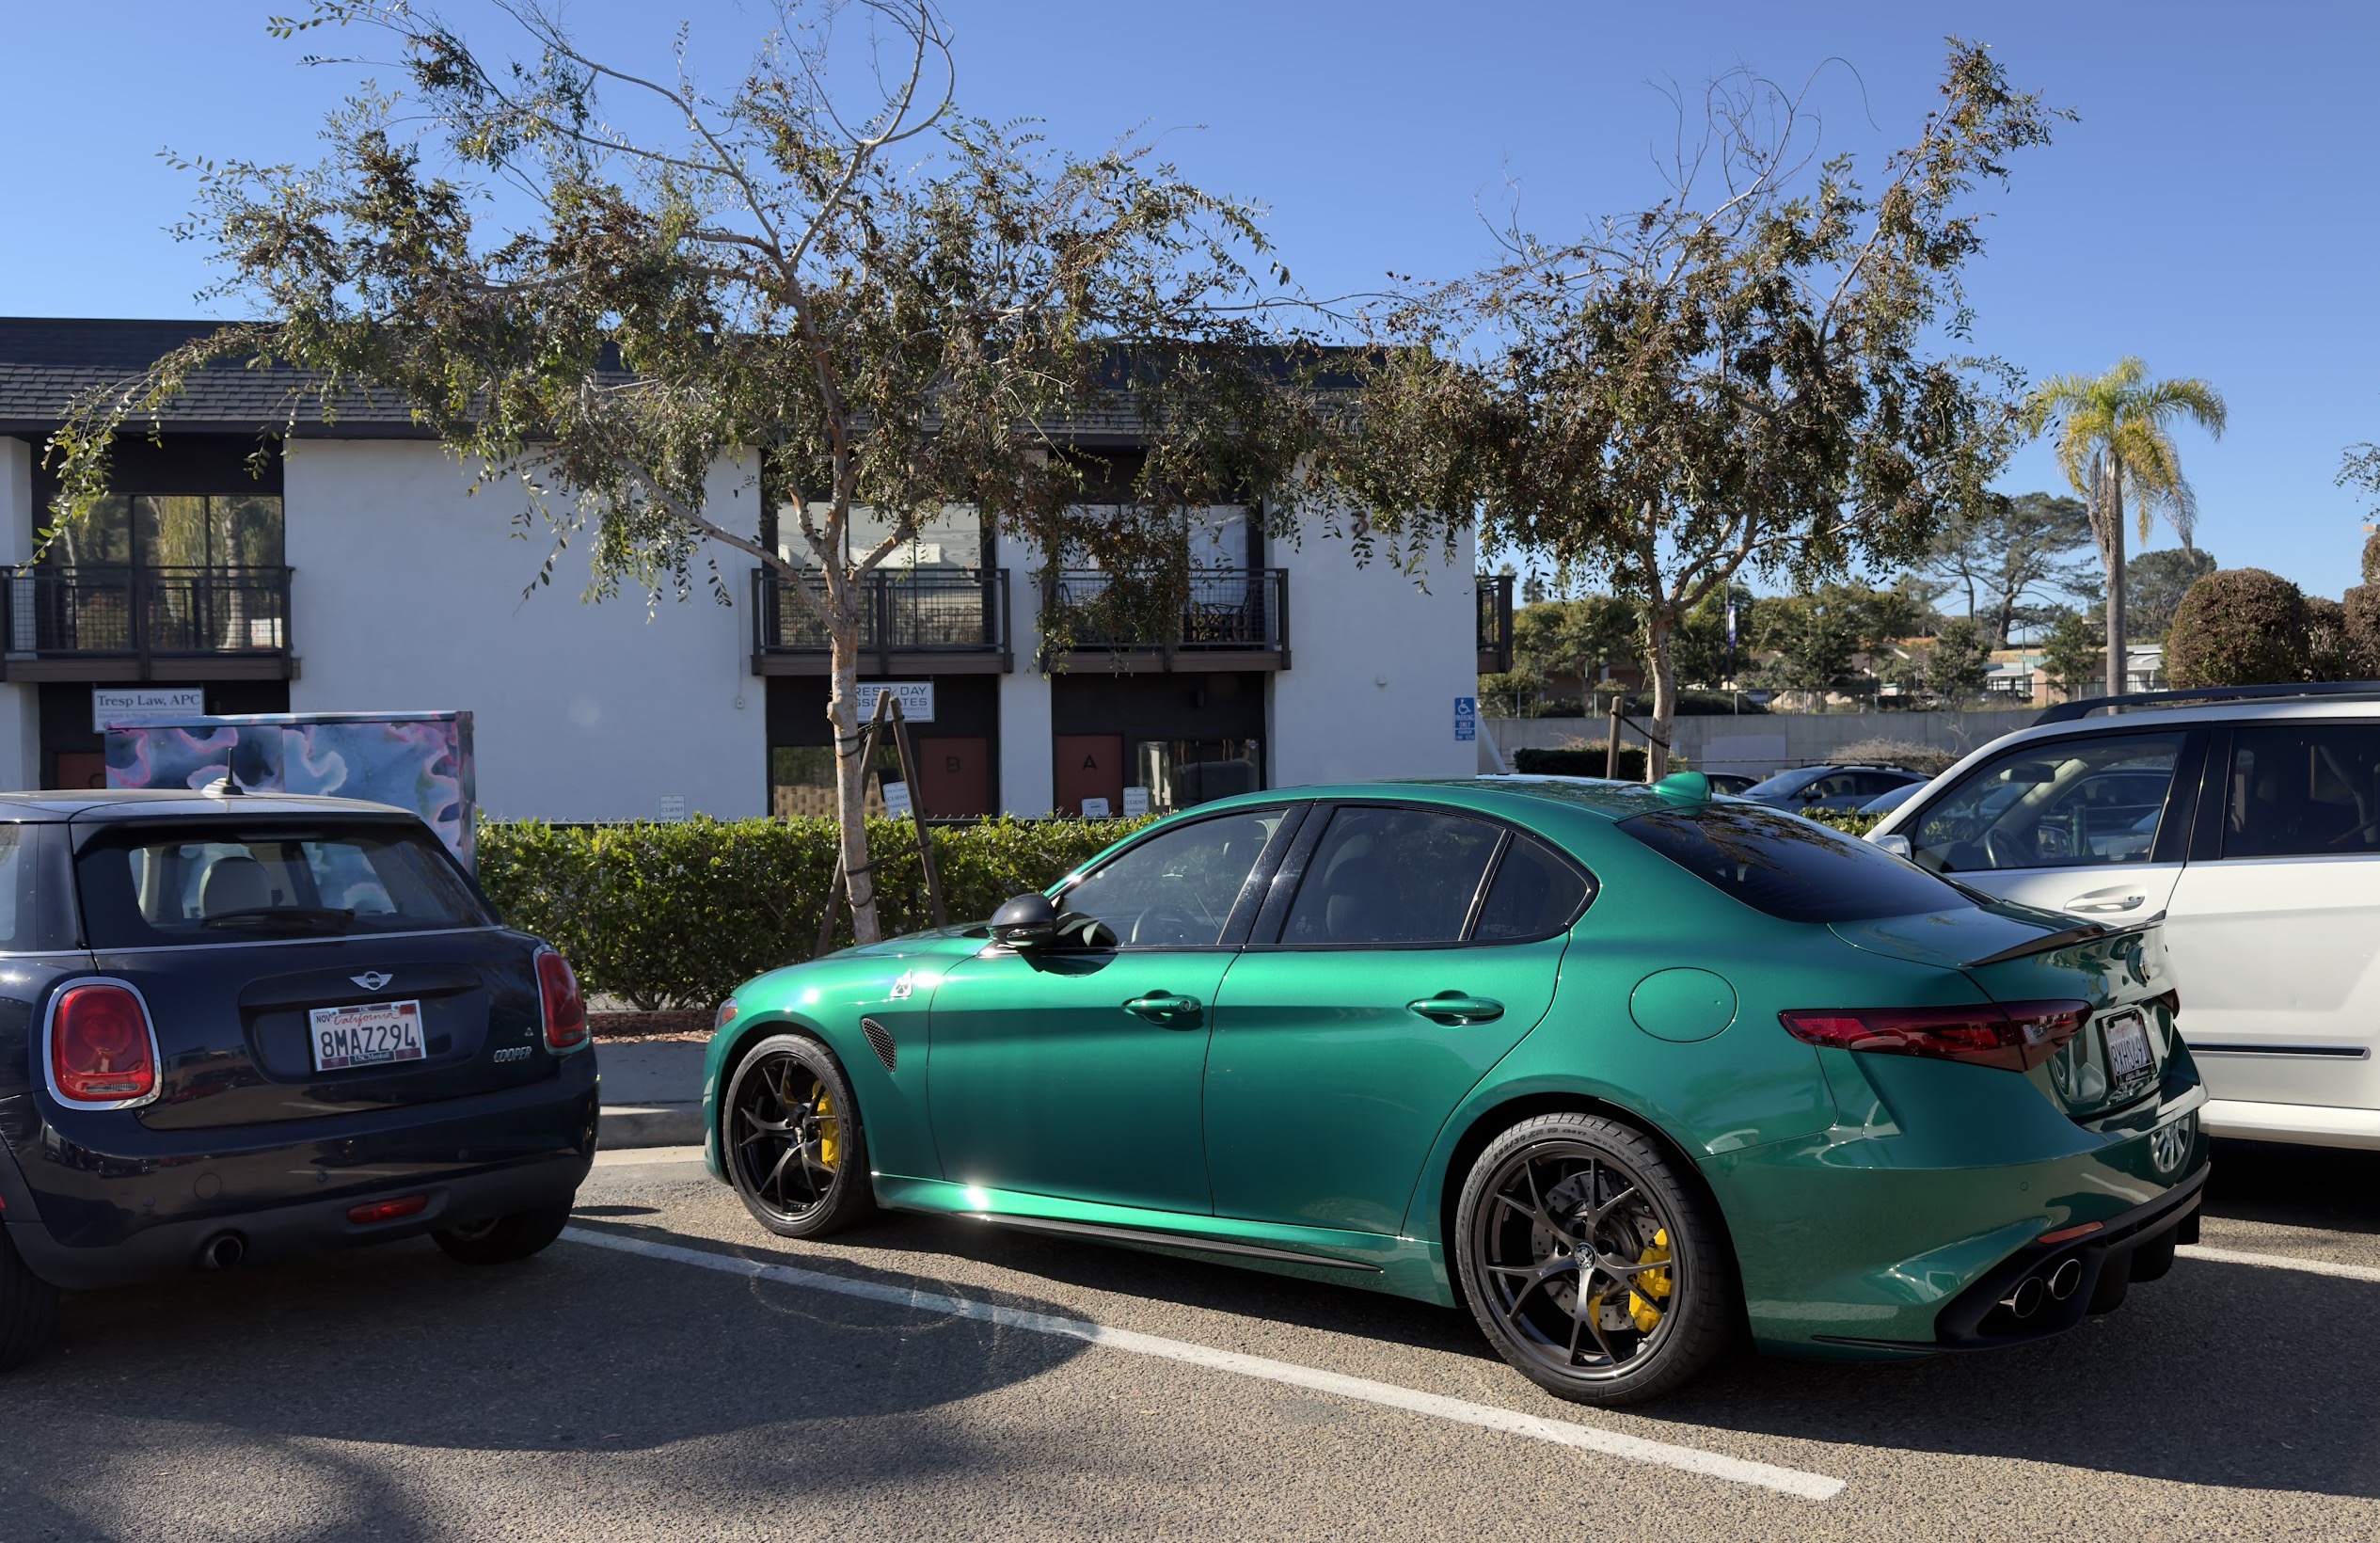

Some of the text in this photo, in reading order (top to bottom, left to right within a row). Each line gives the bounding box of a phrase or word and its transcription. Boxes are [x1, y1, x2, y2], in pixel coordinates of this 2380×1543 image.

[900, 686, 927, 696] DAY
[97, 694, 200, 708] Tresp Law, APC
[946, 756, 960, 772] B
[1083, 754, 1098, 770] A
[887, 793, 909, 802] CLIENT
[316, 1014, 332, 1024] NOV
[333, 1011, 401, 1027] California
[320, 1023, 417, 1058] 8MAZ294
[493, 1045, 532, 1063] COOPER
